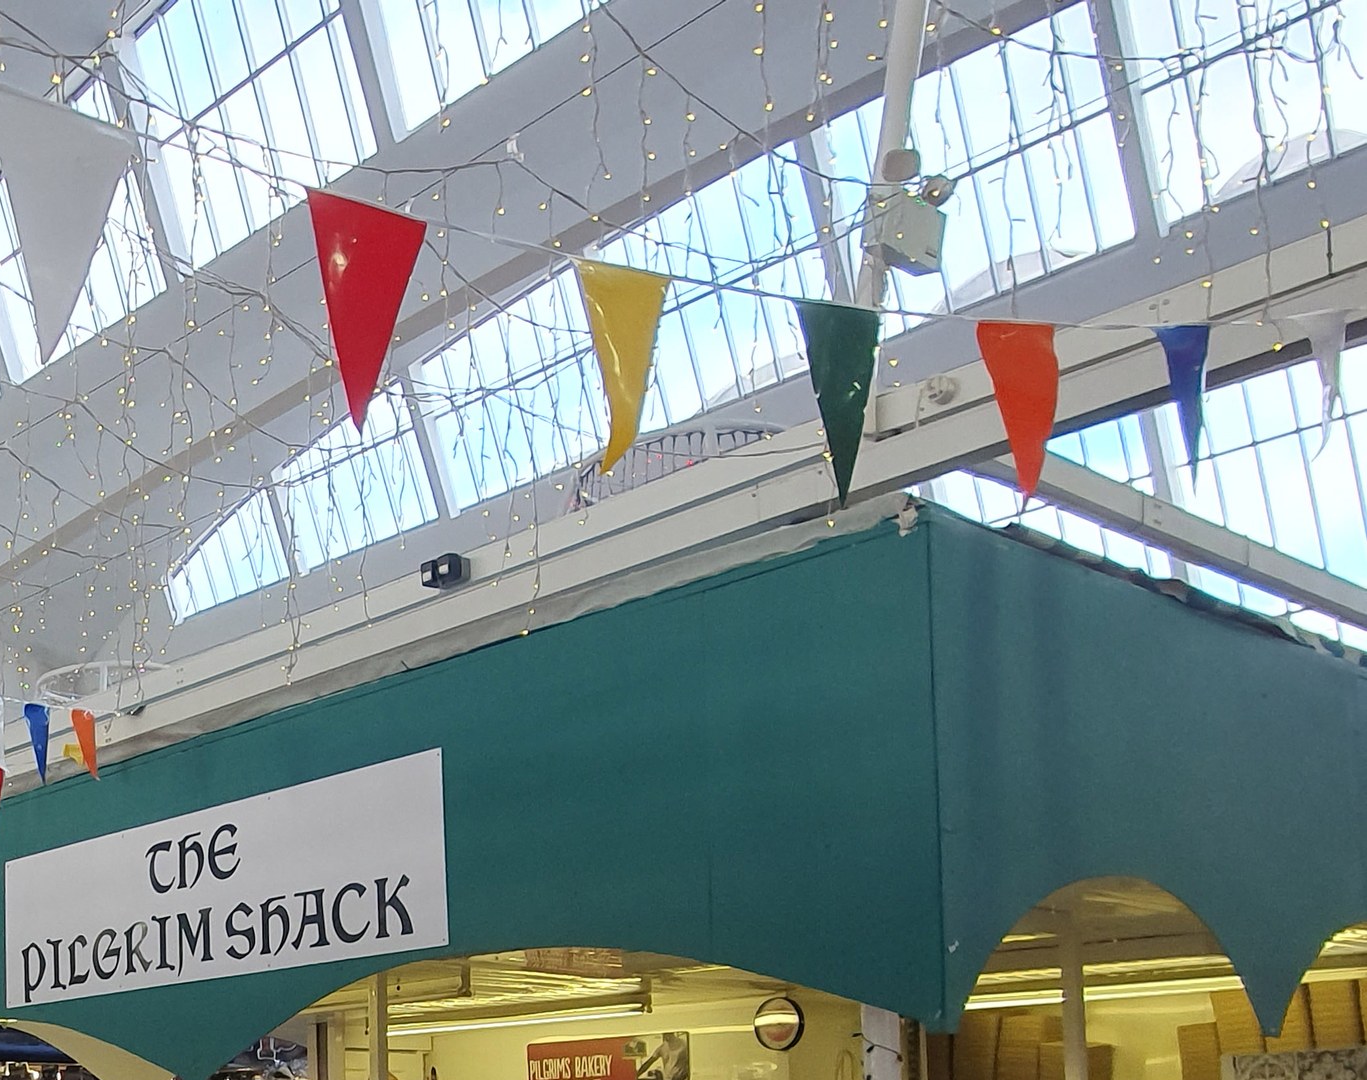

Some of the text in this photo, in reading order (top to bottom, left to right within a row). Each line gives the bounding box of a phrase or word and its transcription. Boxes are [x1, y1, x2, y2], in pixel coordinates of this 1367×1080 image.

[145, 823, 241, 894] THE
[21, 873, 414, 1003] PILGRIM SHACK
[529, 1054, 612, 1080] PILGRIMS BAKERY
